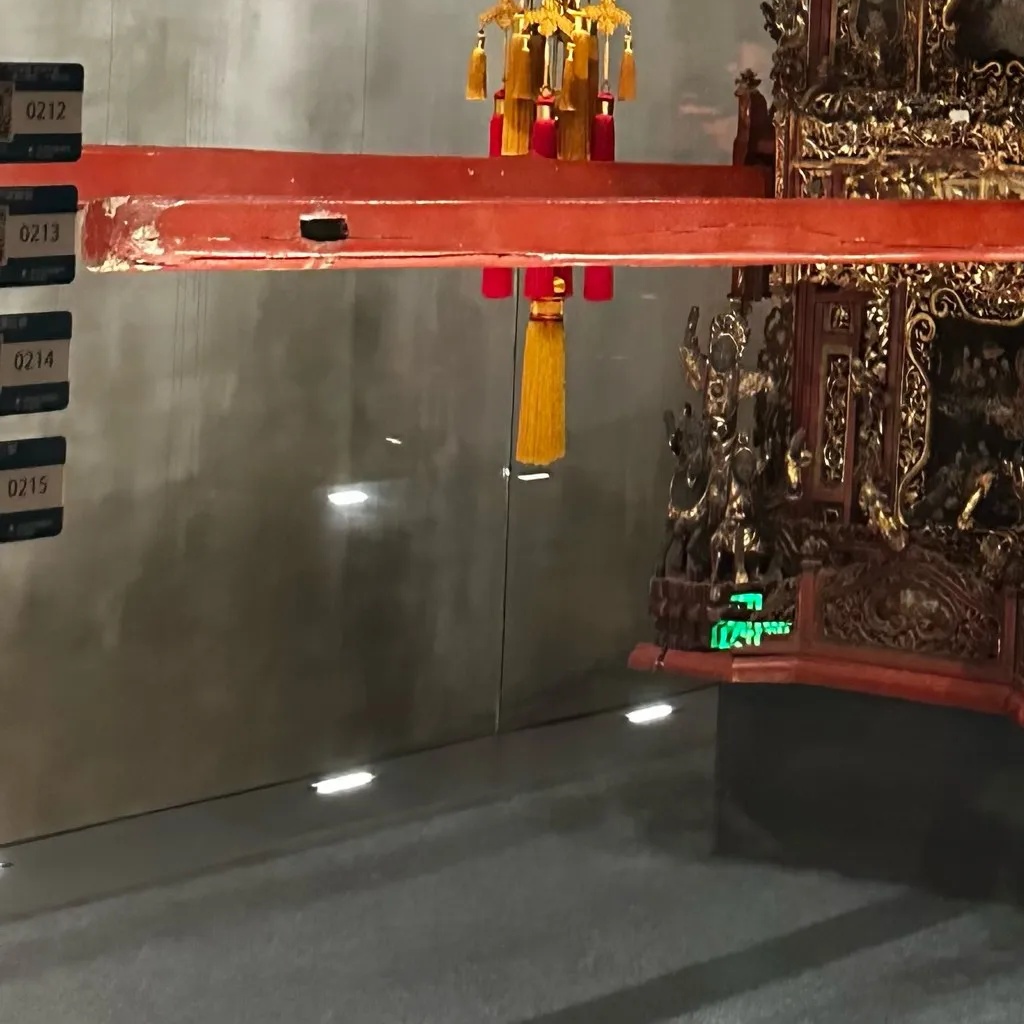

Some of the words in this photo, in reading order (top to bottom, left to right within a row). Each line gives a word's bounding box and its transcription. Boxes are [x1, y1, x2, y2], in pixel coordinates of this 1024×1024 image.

[26, 101, 66, 121] 0212
[19, 222, 60, 243] 0213
[14, 350, 54, 371] 0214
[8, 475, 48, 498] 0215
